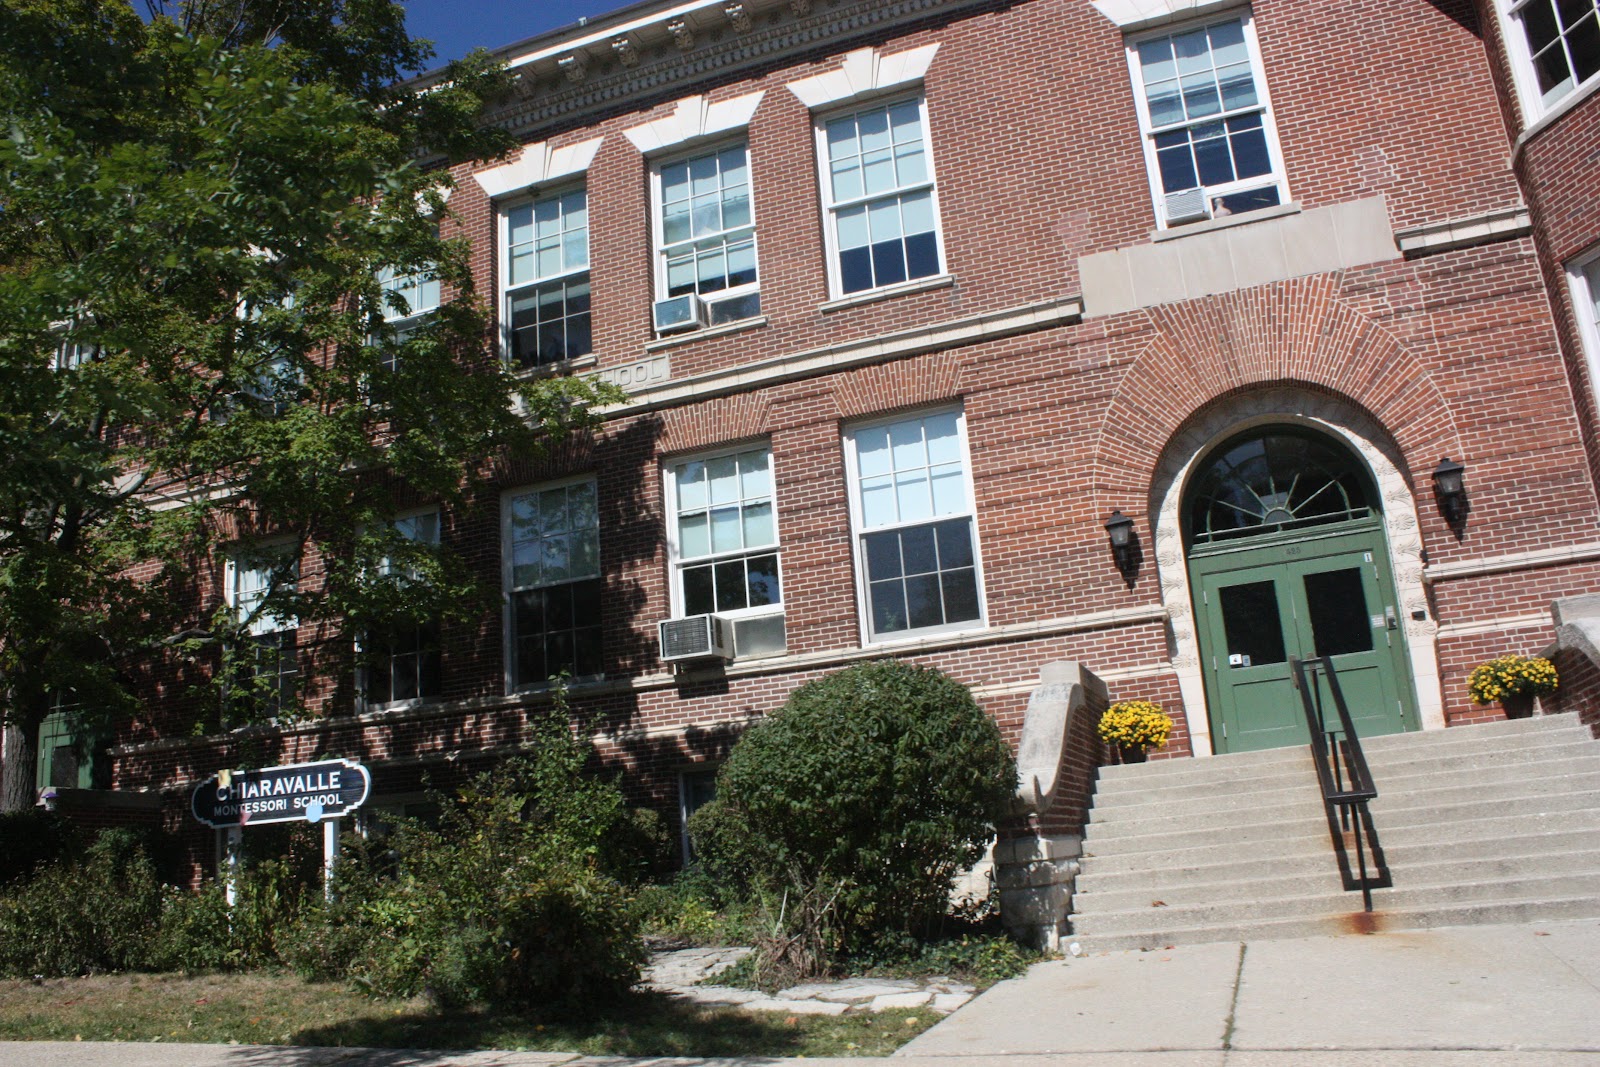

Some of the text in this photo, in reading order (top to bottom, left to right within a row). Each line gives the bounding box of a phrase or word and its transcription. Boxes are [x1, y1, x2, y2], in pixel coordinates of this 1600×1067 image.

[216, 771, 341, 801] CHIARAVALLE
[213, 793, 344, 817] MONTESSORI SCHOOL
